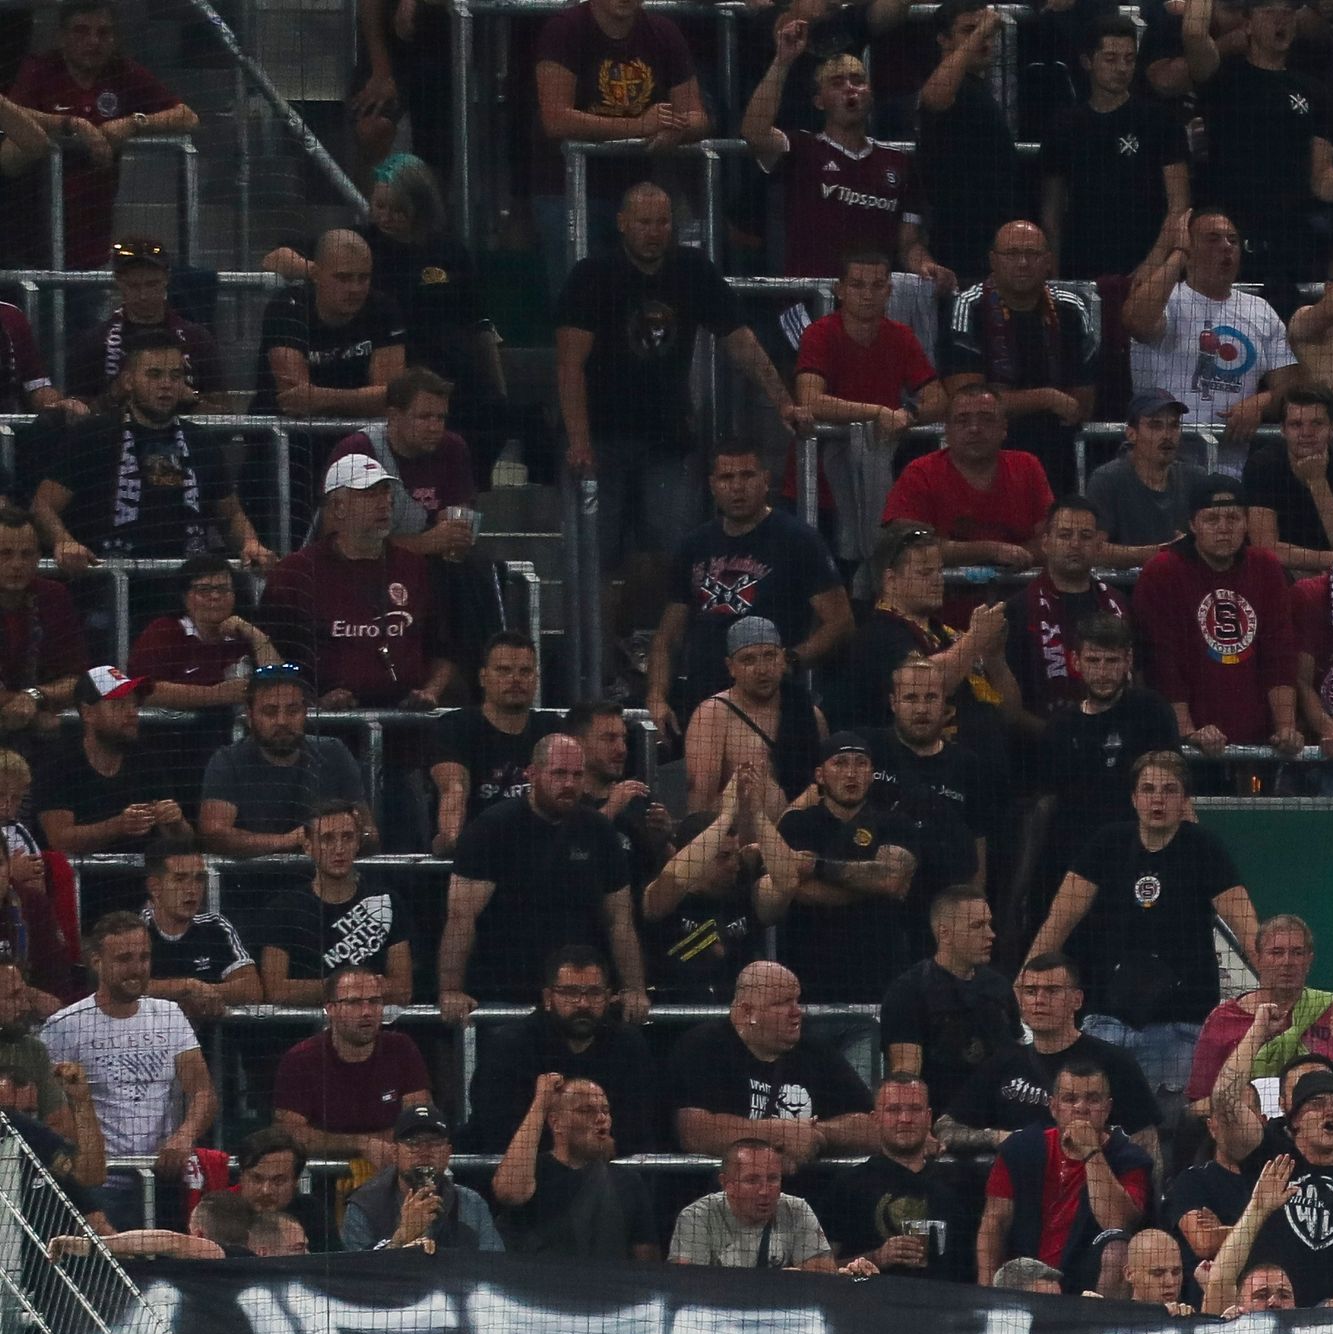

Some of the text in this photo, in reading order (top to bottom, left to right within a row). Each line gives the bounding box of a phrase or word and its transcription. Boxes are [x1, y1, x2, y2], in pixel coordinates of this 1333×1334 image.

[834, 185, 899, 213] Tipsport
[331, 619, 406, 638] Euroel
[330, 904, 369, 936] THE
